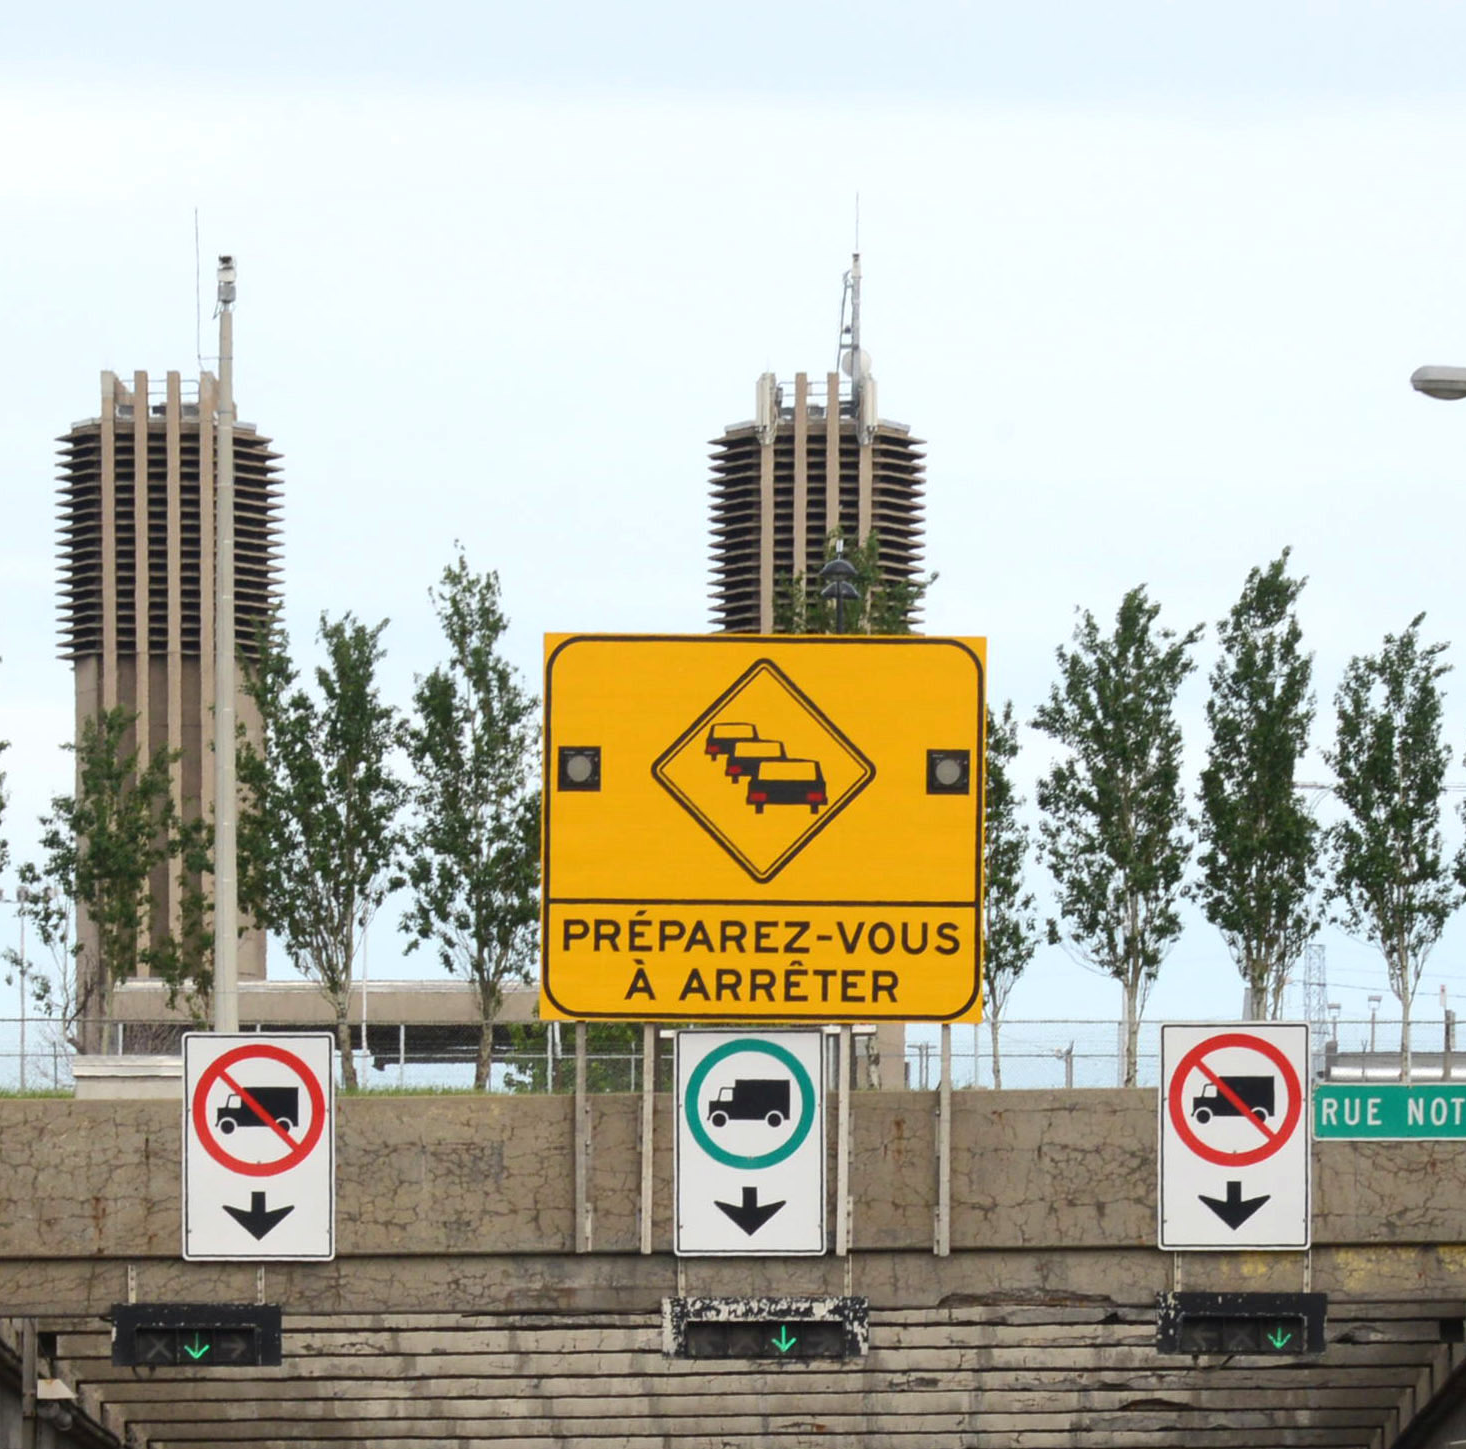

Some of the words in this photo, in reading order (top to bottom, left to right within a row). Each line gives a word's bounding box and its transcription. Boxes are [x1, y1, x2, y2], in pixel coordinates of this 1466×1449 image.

[562, 910, 961, 956] PRÉPAREZ-VOUS
[624, 958, 657, 1001] À
[678, 959, 900, 1003] ARRÊTER
[1321, 1096, 1383, 1126] RUE
